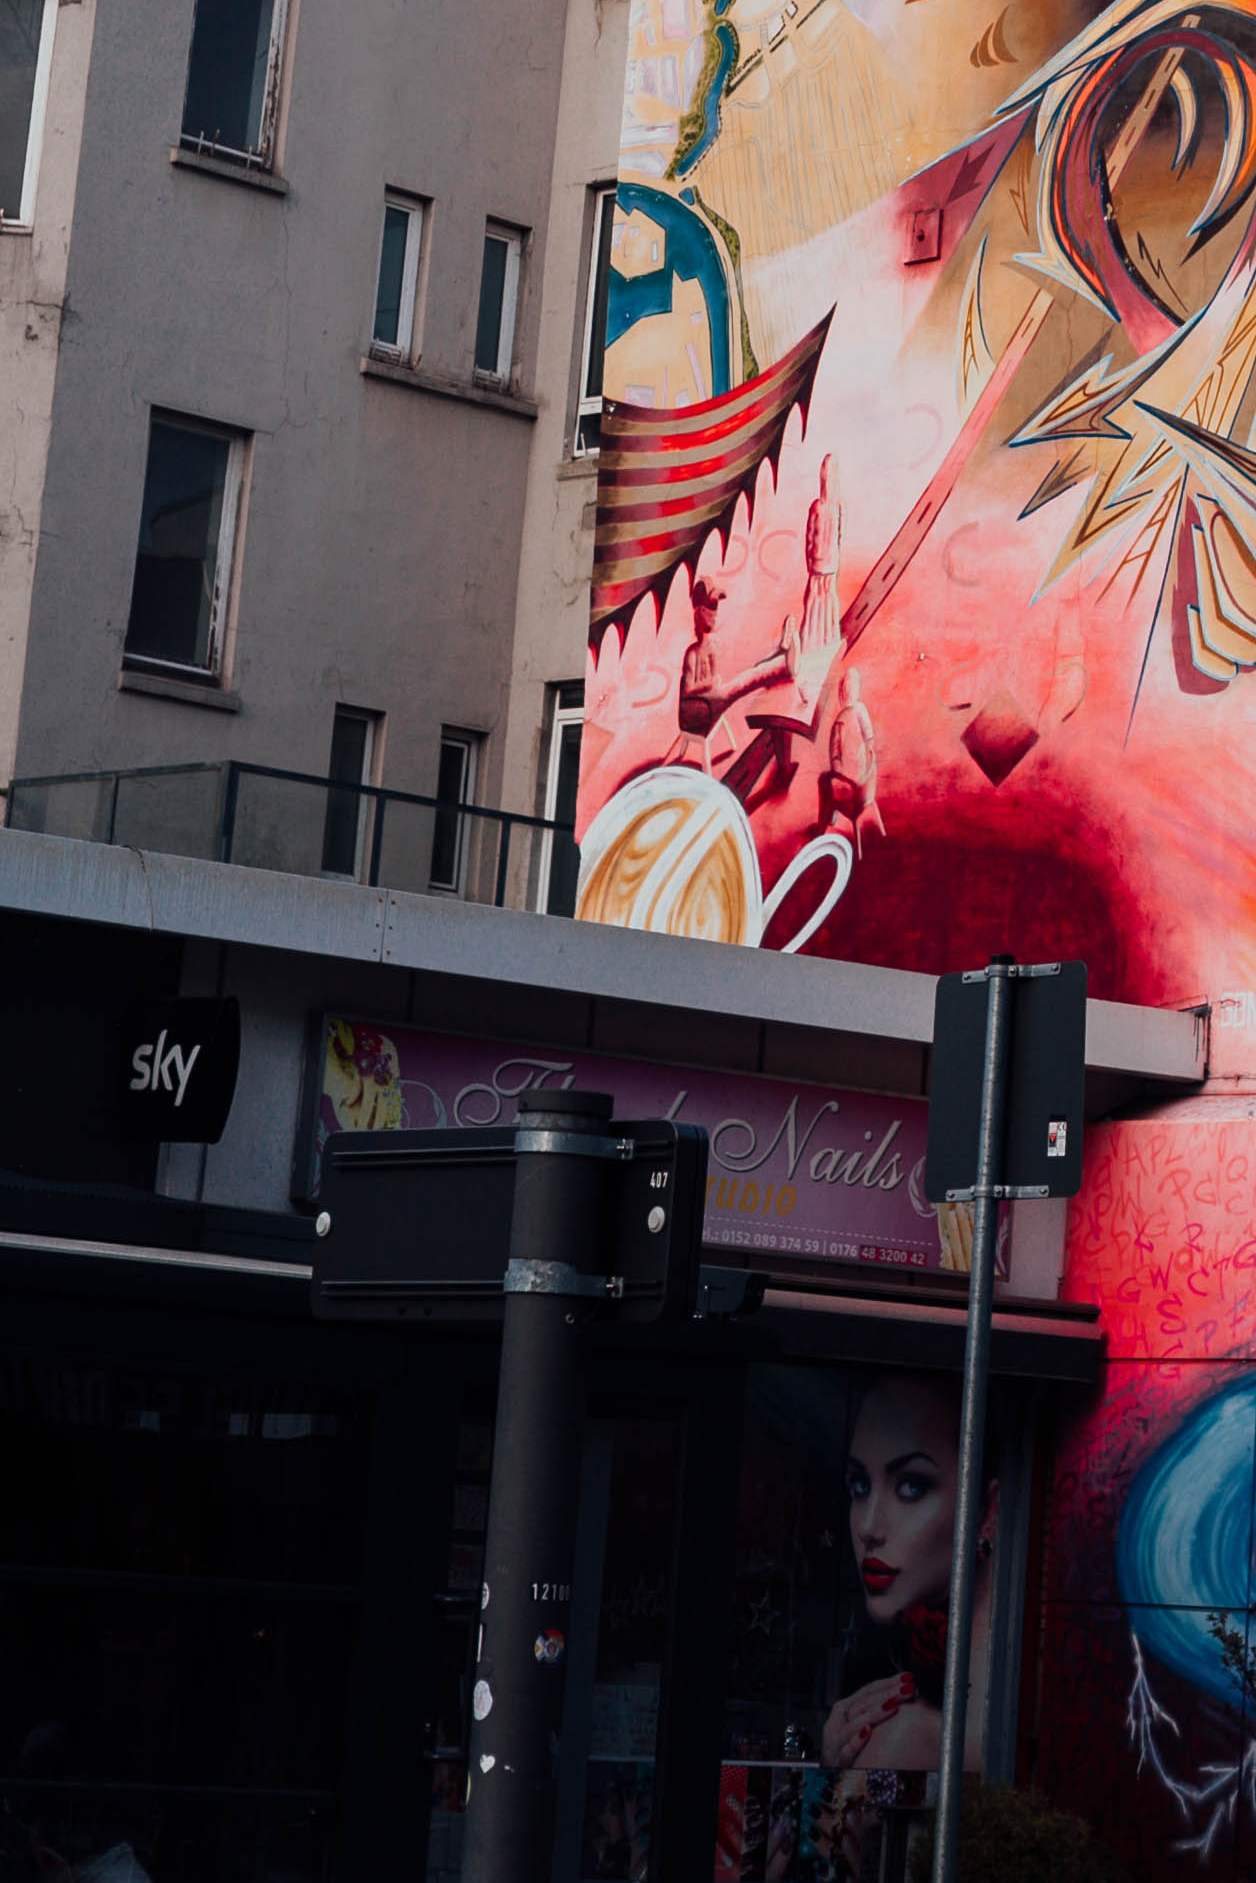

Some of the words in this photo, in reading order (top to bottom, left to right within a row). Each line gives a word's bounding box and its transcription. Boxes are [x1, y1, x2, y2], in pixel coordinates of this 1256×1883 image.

[129, 1028, 201, 1107] sky
[711, 1094, 904, 1190] Nails
[649, 1171, 669, 1189] 407
[704, 1176, 797, 1216] TUDIO
[722, 1229, 750, 1245] 0152
[754, 1233, 777, 1248] 089
[780, 1236, 801, 1251] 374
[805, 1239, 820, 1253] 59
[829, 1242, 857, 1257] 0176
[861, 1246, 877, 1260] 48
[879, 1248, 907, 1263] 3200
[910, 1252, 926, 1266] 42
